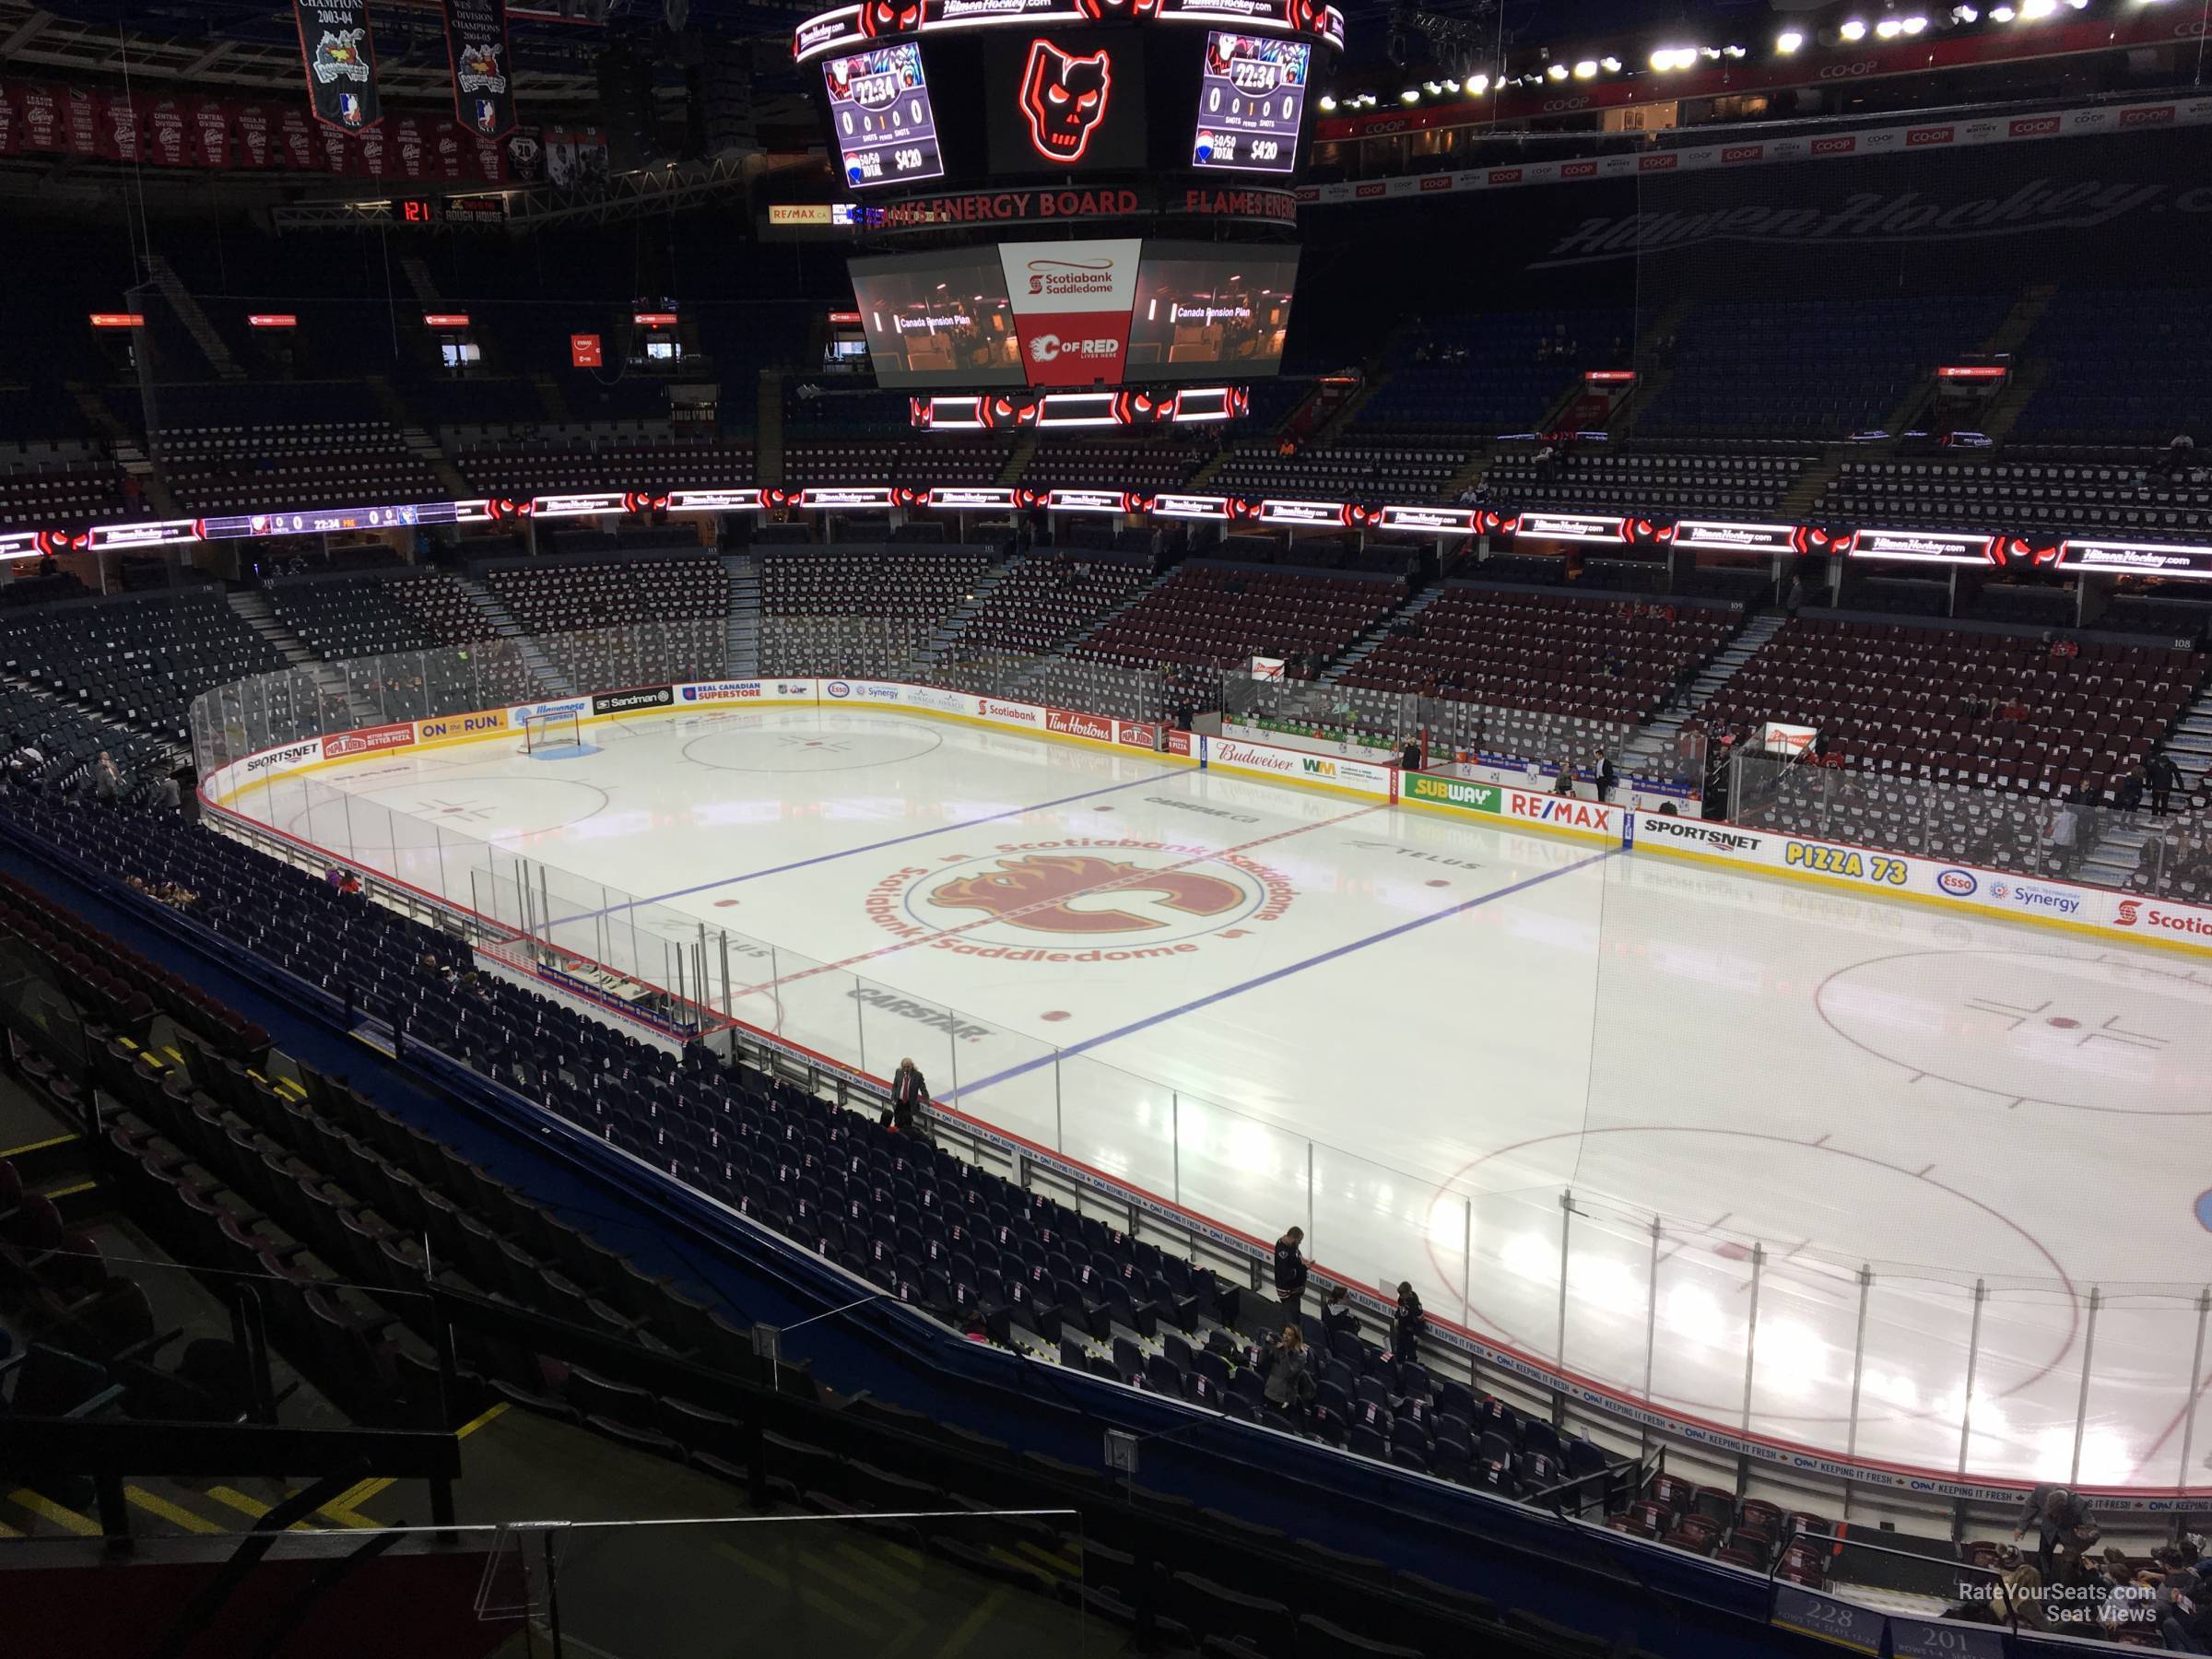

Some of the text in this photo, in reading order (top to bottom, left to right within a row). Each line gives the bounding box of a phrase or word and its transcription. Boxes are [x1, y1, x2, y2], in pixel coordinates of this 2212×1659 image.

[317, 10, 353, 24] 2003-04
[457, 11, 494, 22] DIVISION
[452, 19, 500, 32] CHAMPIONS
[1235, 64, 1276, 88] 22:34
[1820, 60, 1877, 79] CO-OP
[856, 76, 896, 104] 22:34
[1210, 88, 1220, 112] 0
[1283, 96, 1293, 120] 0
[1543, 96, 1590, 112] CO-OP
[911, 99, 923, 124] 0
[2126, 110, 2169, 122] CO-OP
[842, 111, 853, 135] 0
[1365, 120, 1405, 135] CO-OP
[2015, 121, 2054, 133] CO-OP
[1213, 135, 1237, 147] 50/50
[1912, 131, 1948, 142] CO-OP
[1213, 147, 1234, 160] TOTAL
[1251, 140, 1277, 160] $420
[1816, 140, 1850, 151] CO-OP
[859, 152, 880, 164] 50/50
[895, 148, 922, 171] $420
[1643, 157, 1674, 167] CO-OP
[1726, 149, 1759, 159] CO-OP
[862, 164, 883, 177] TOTAL
[1491, 170, 1522, 182] CO-OP
[1564, 165, 1594, 176] CO-OP
[1359, 186, 1383, 194] CO-OP
[1424, 179, 1450, 189] CO-OP
[933, 194, 1031, 221] ENERGY
[1040, 191, 1137, 218] BOARD
[1186, 190, 1263, 215] FLAMES
[445, 209, 502, 222] ROUGH HOUSE
[773, 209, 815, 218] RE/MAX
[1046, 272, 1112, 284] Scotiabank
[1046, 284, 1113, 295] Saddledome
[1178, 307, 1251, 317] Canada Pension Plan
[900, 314, 971, 328] Canada Pension Plan
[1062, 338, 1119, 354] OF RED
[1691, 528, 1772, 544] HitmenHockey.com
[1873, 536, 1966, 555] HitmenHockey.com
[2081, 548, 2190, 568] HitmenHockey.com
[611, 694, 657, 708] Sandman
[698, 688, 761, 700] SUPERSTORE
[868, 687, 899, 700] Synergy
[990, 704, 1036, 722] Scotiabank
[422, 722, 461, 737] ON the
[1048, 712, 1110, 739] Tim Hortons
[325, 739, 343, 756] PAPA
[367, 735, 391, 747] BETTER
[247, 743, 319, 771] SPORTSNET
[1216, 742, 1294, 771] Budweiser
[1302, 758, 1336, 776] WM
[1415, 779, 1492, 806] SUBWAY
[1512, 794, 1609, 830] RE/MAX
[1645, 819, 1761, 851] SPORTSNET
[1395, 848, 1483, 870] TELUS
[1785, 841, 1907, 885] PIZZA 73
[995, 838, 1301, 922] Scotiabank Saddledome
[2015, 887, 2079, 913] Synergy
[864, 866, 1200, 963] Scotiabank Saddledome
[1516, 1362, 1541, 1381] KEEPING
[1542, 1373, 1549, 1382] IT
[1549, 1375, 1570, 1393] FRESH
[1605, 1399, 1633, 1417] KEEPING
[1635, 1409, 1642, 1418] IT
[1642, 1411, 1665, 1429] FRESH
[1709, 1434, 1776, 1461] KEEPING IT FRESH
[1820, 1462, 1855, 1479] KEEPING
[1856, 1469, 1865, 1480] IT
[1866, 1472, 1892, 1486] FRESH
[1938, 1484, 1974, 1498] KEEPING
[1975, 1488, 1983, 1498] IT
[1985, 1489, 2012, 1502] FRESH
[2094, 1500, 2131, 1510] IT FRESH
[2175, 1501, 2208, 1511] KEEPING
[1806, 1600, 1853, 1628] 228
[1922, 1627, 1968, 1652] 201
